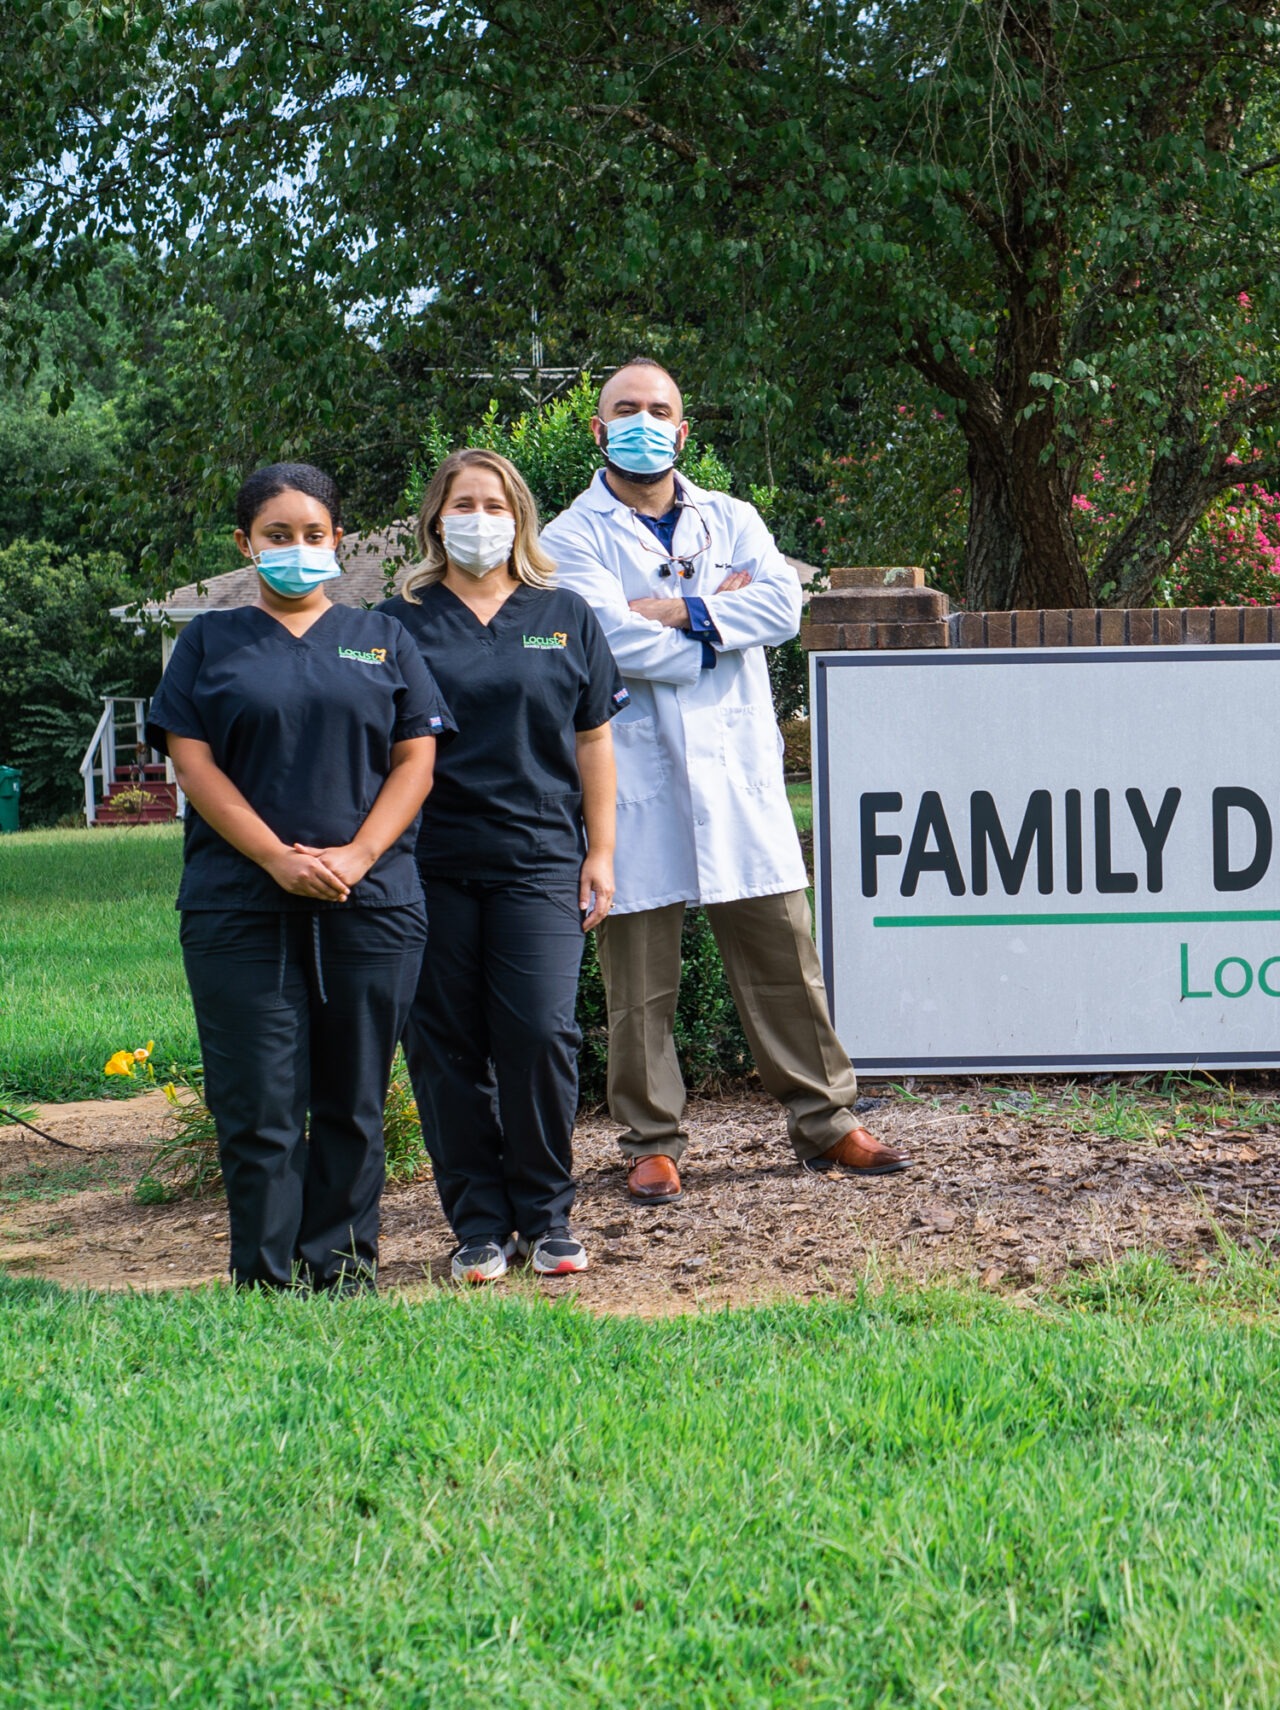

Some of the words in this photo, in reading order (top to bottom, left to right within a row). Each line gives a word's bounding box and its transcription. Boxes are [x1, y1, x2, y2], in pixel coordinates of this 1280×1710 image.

[522, 634, 560, 646] Locust
[338, 646, 378, 661] Locust
[859, 787, 1182, 898] FAMILY
